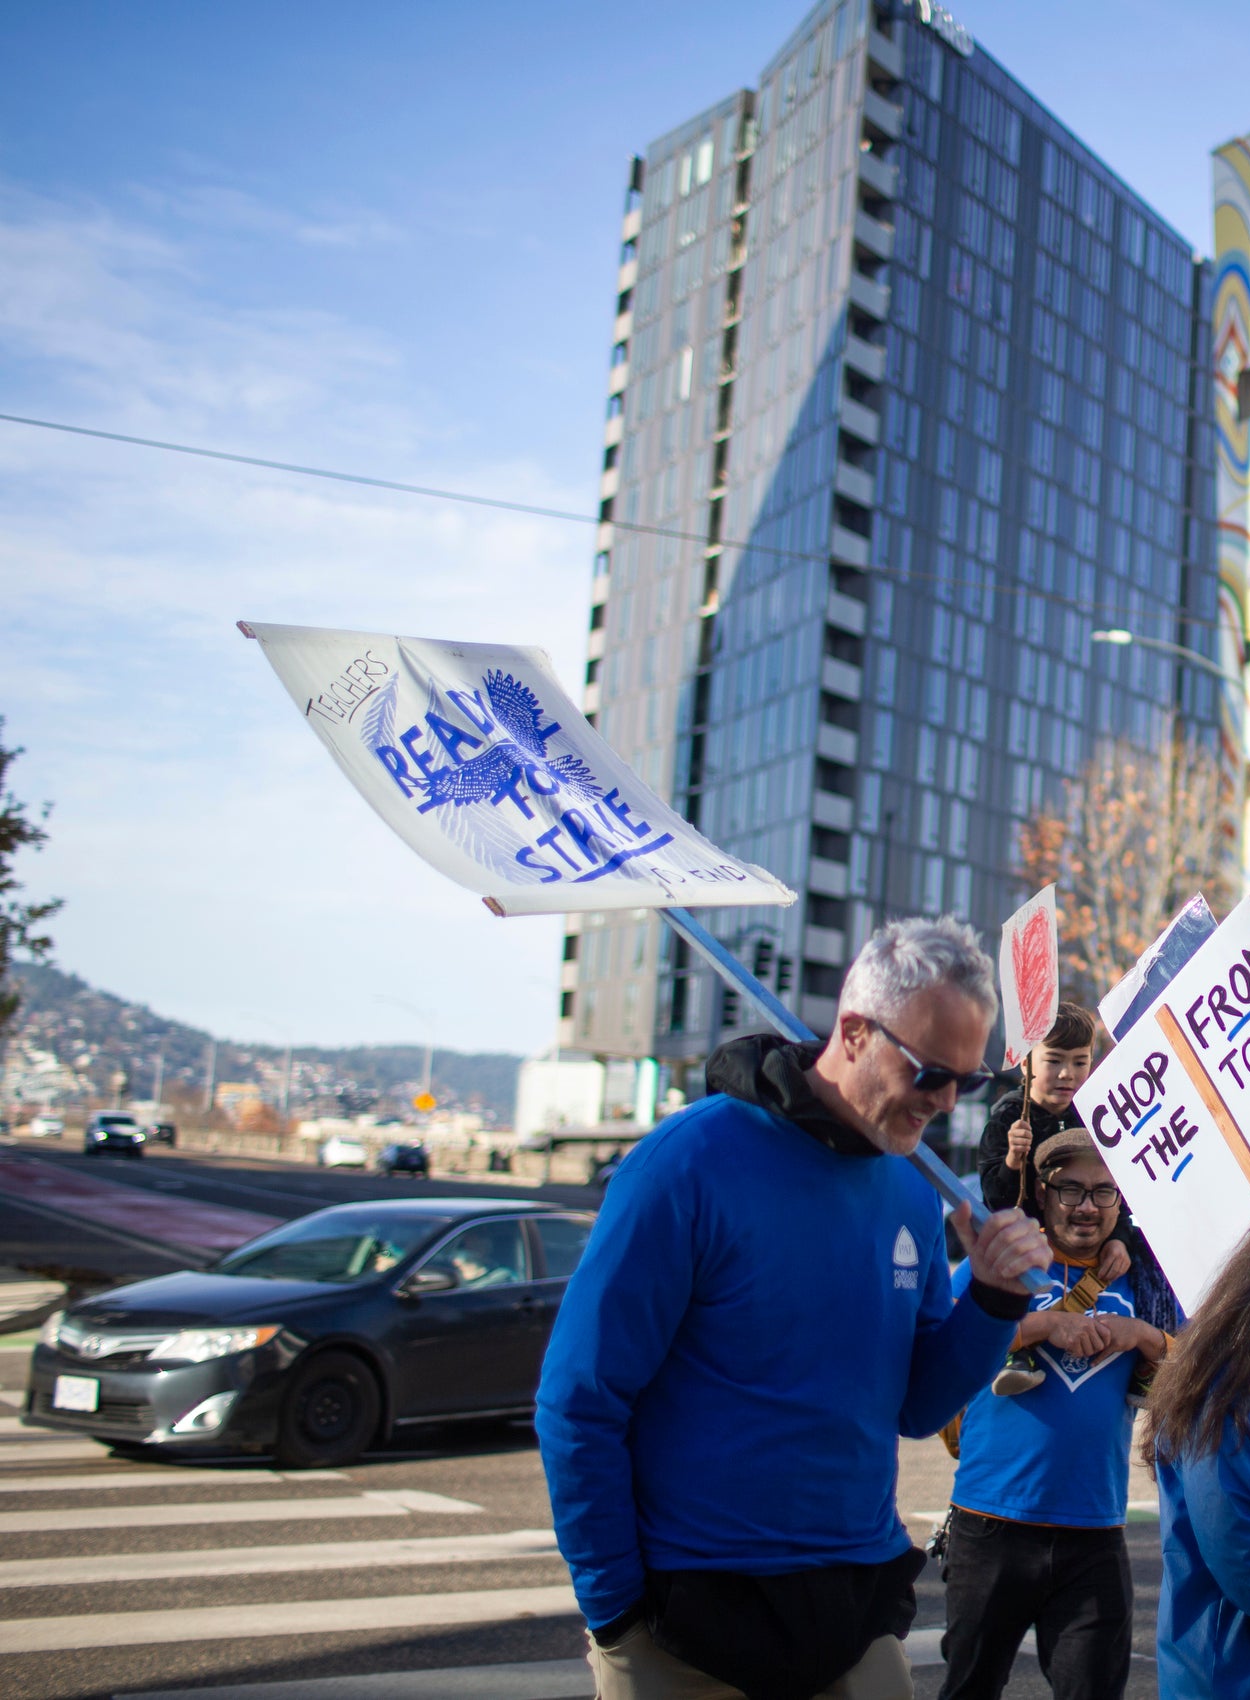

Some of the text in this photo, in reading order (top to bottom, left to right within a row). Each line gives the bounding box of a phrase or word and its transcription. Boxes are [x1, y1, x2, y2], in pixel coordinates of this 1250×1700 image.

[305, 649, 389, 725] TEACHERS
[376, 688, 495, 799] READY
[490, 762, 562, 820] TO
[515, 787, 652, 883] STRKE
[1091, 1052, 1169, 1148] CHOP
[1131, 1105, 1199, 1181] THE
